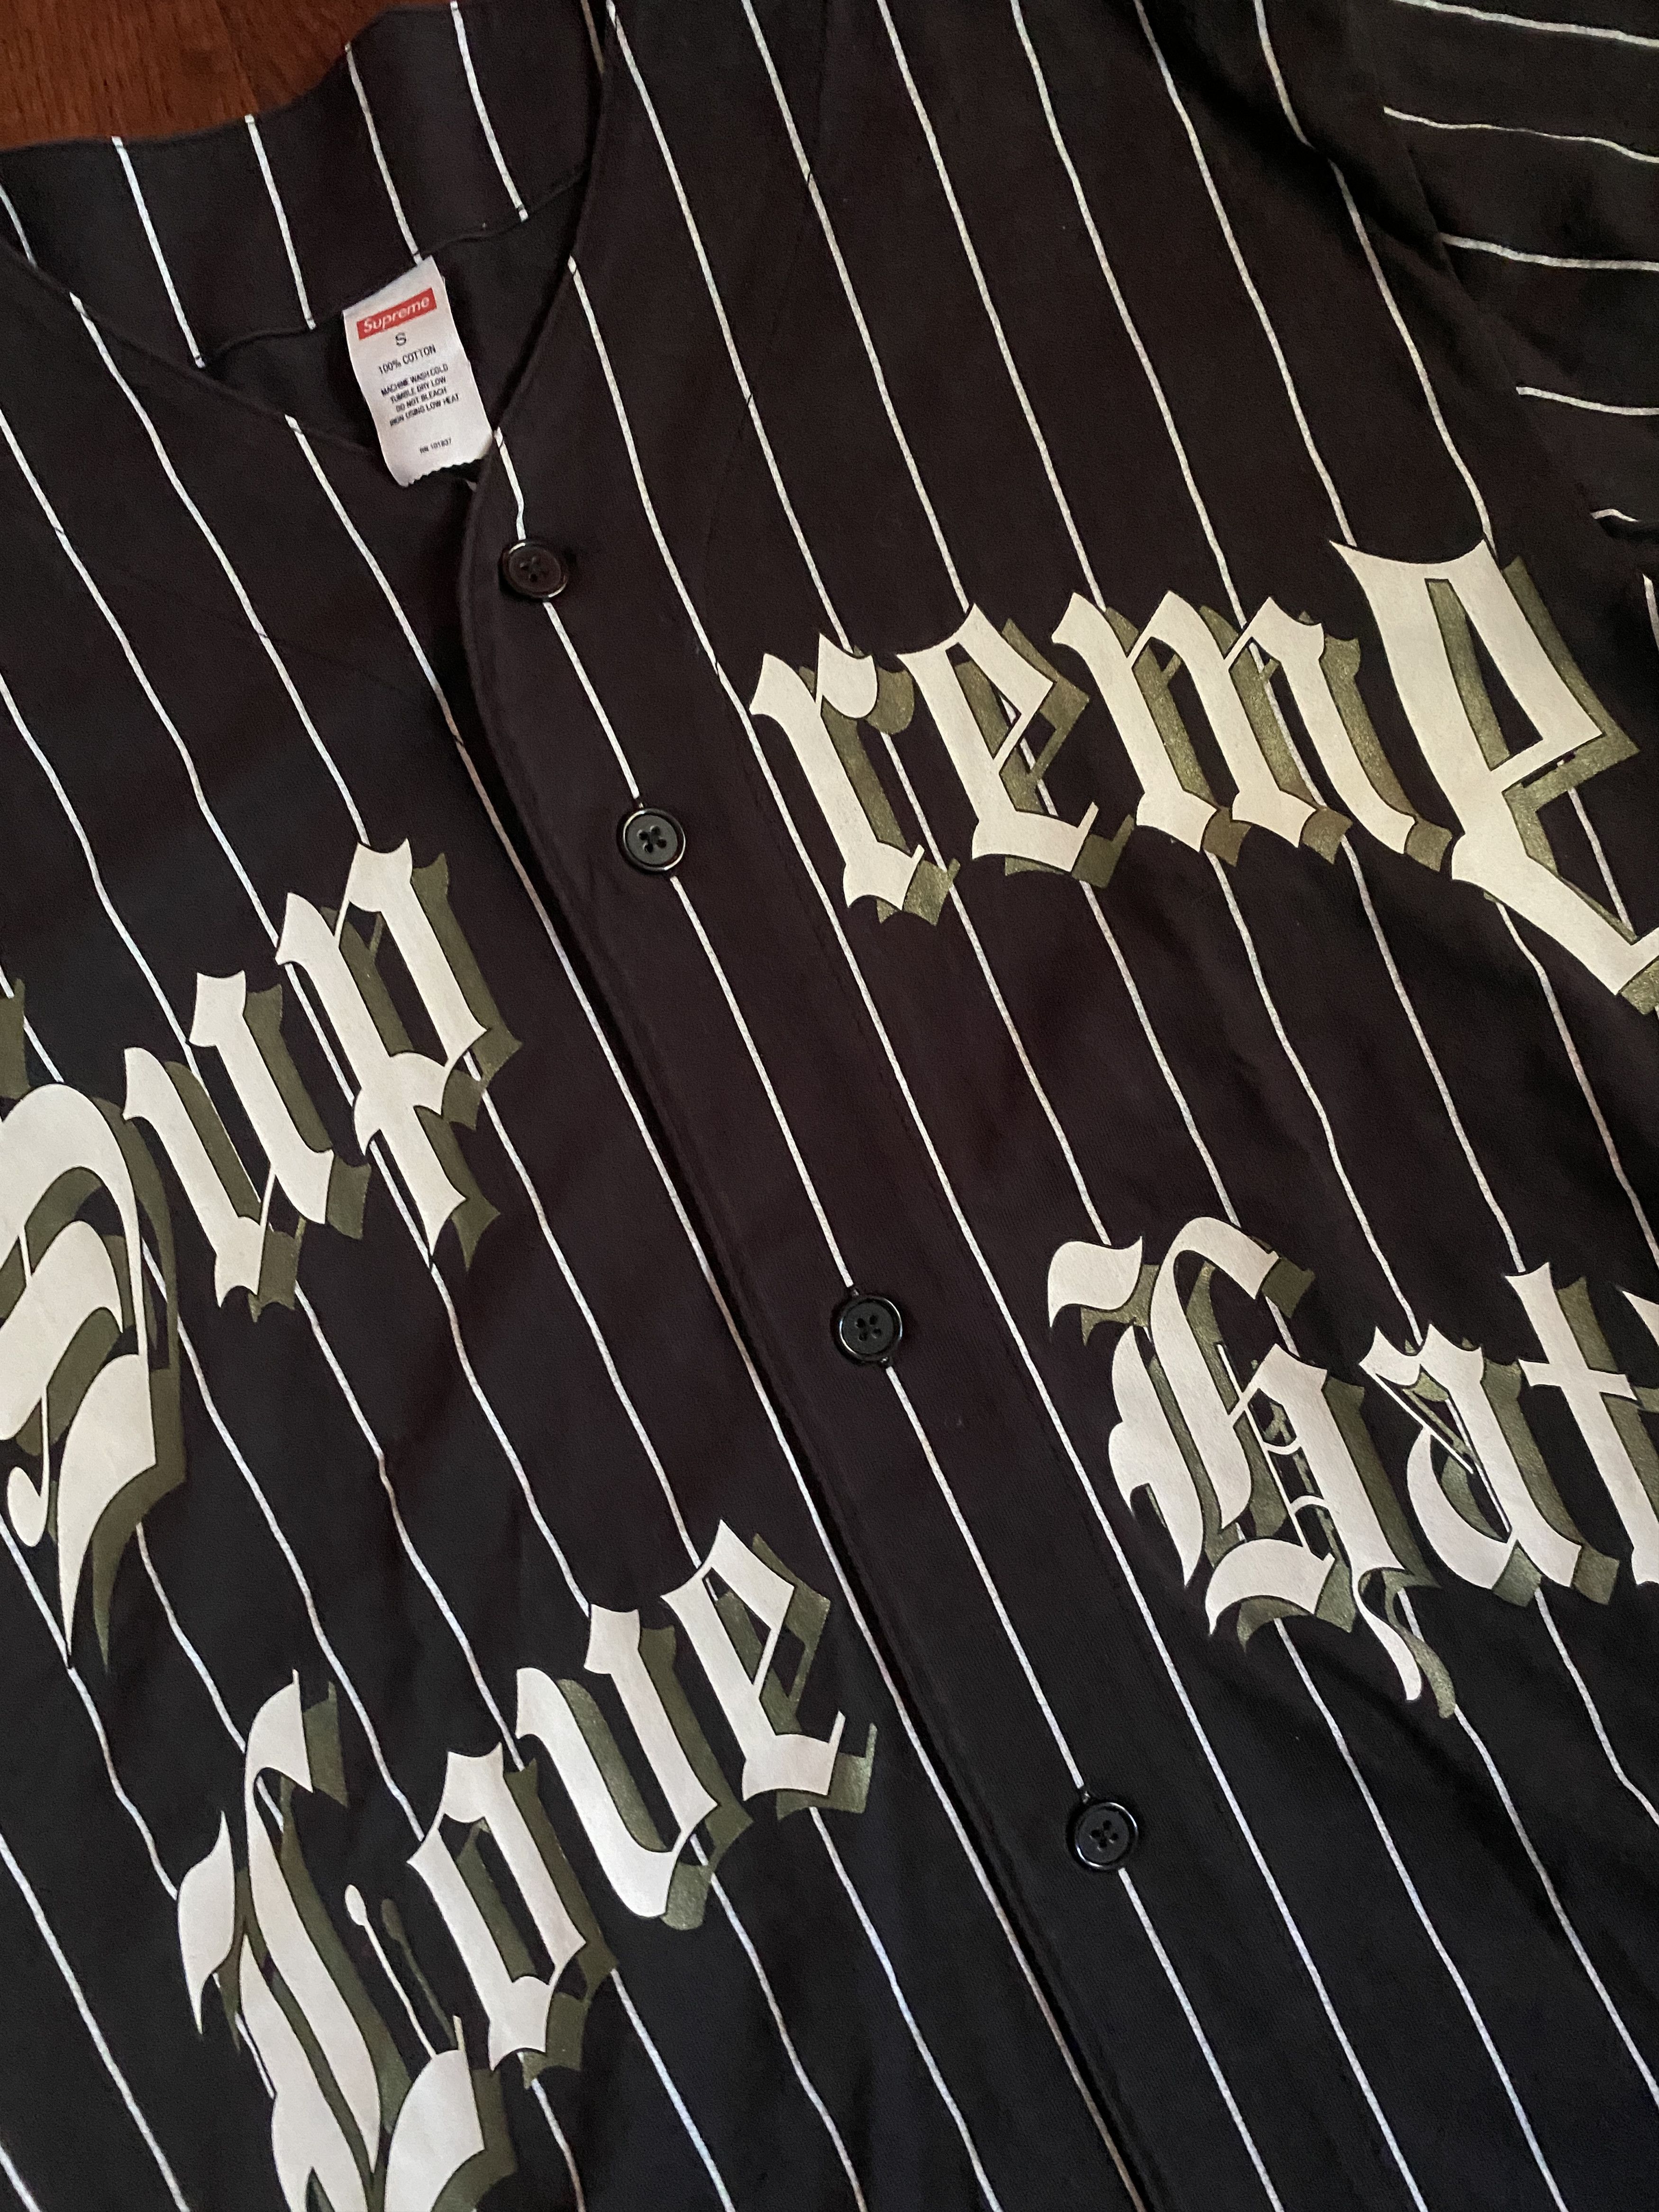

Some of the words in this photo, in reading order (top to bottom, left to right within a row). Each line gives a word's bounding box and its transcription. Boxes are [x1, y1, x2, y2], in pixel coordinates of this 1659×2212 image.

[364, 296, 430, 333] Supreme
[395, 332, 407, 346] S
[378, 359, 401, 374] 100%
[402, 344, 436, 364] COTTON
[381, 378, 408, 396] MACHINE
[410, 371, 429, 383] WASH
[430, 363, 448, 376] COLD
[390, 387, 415, 403] TUMBLE
[417, 381, 429, 392] DRY
[431, 375, 446, 387] LOW
[390, 414, 404, 427] IRON
[405, 405, 425, 419] USING
[426, 400, 441, 411] LOW
[443, 393, 459, 405] HEAT
[396, 403, 405, 412] DO
[406, 396, 419, 408] NOT
[421, 386, 447, 402] BLEACH
[1047, 1216, 1659, 1702] Hat
